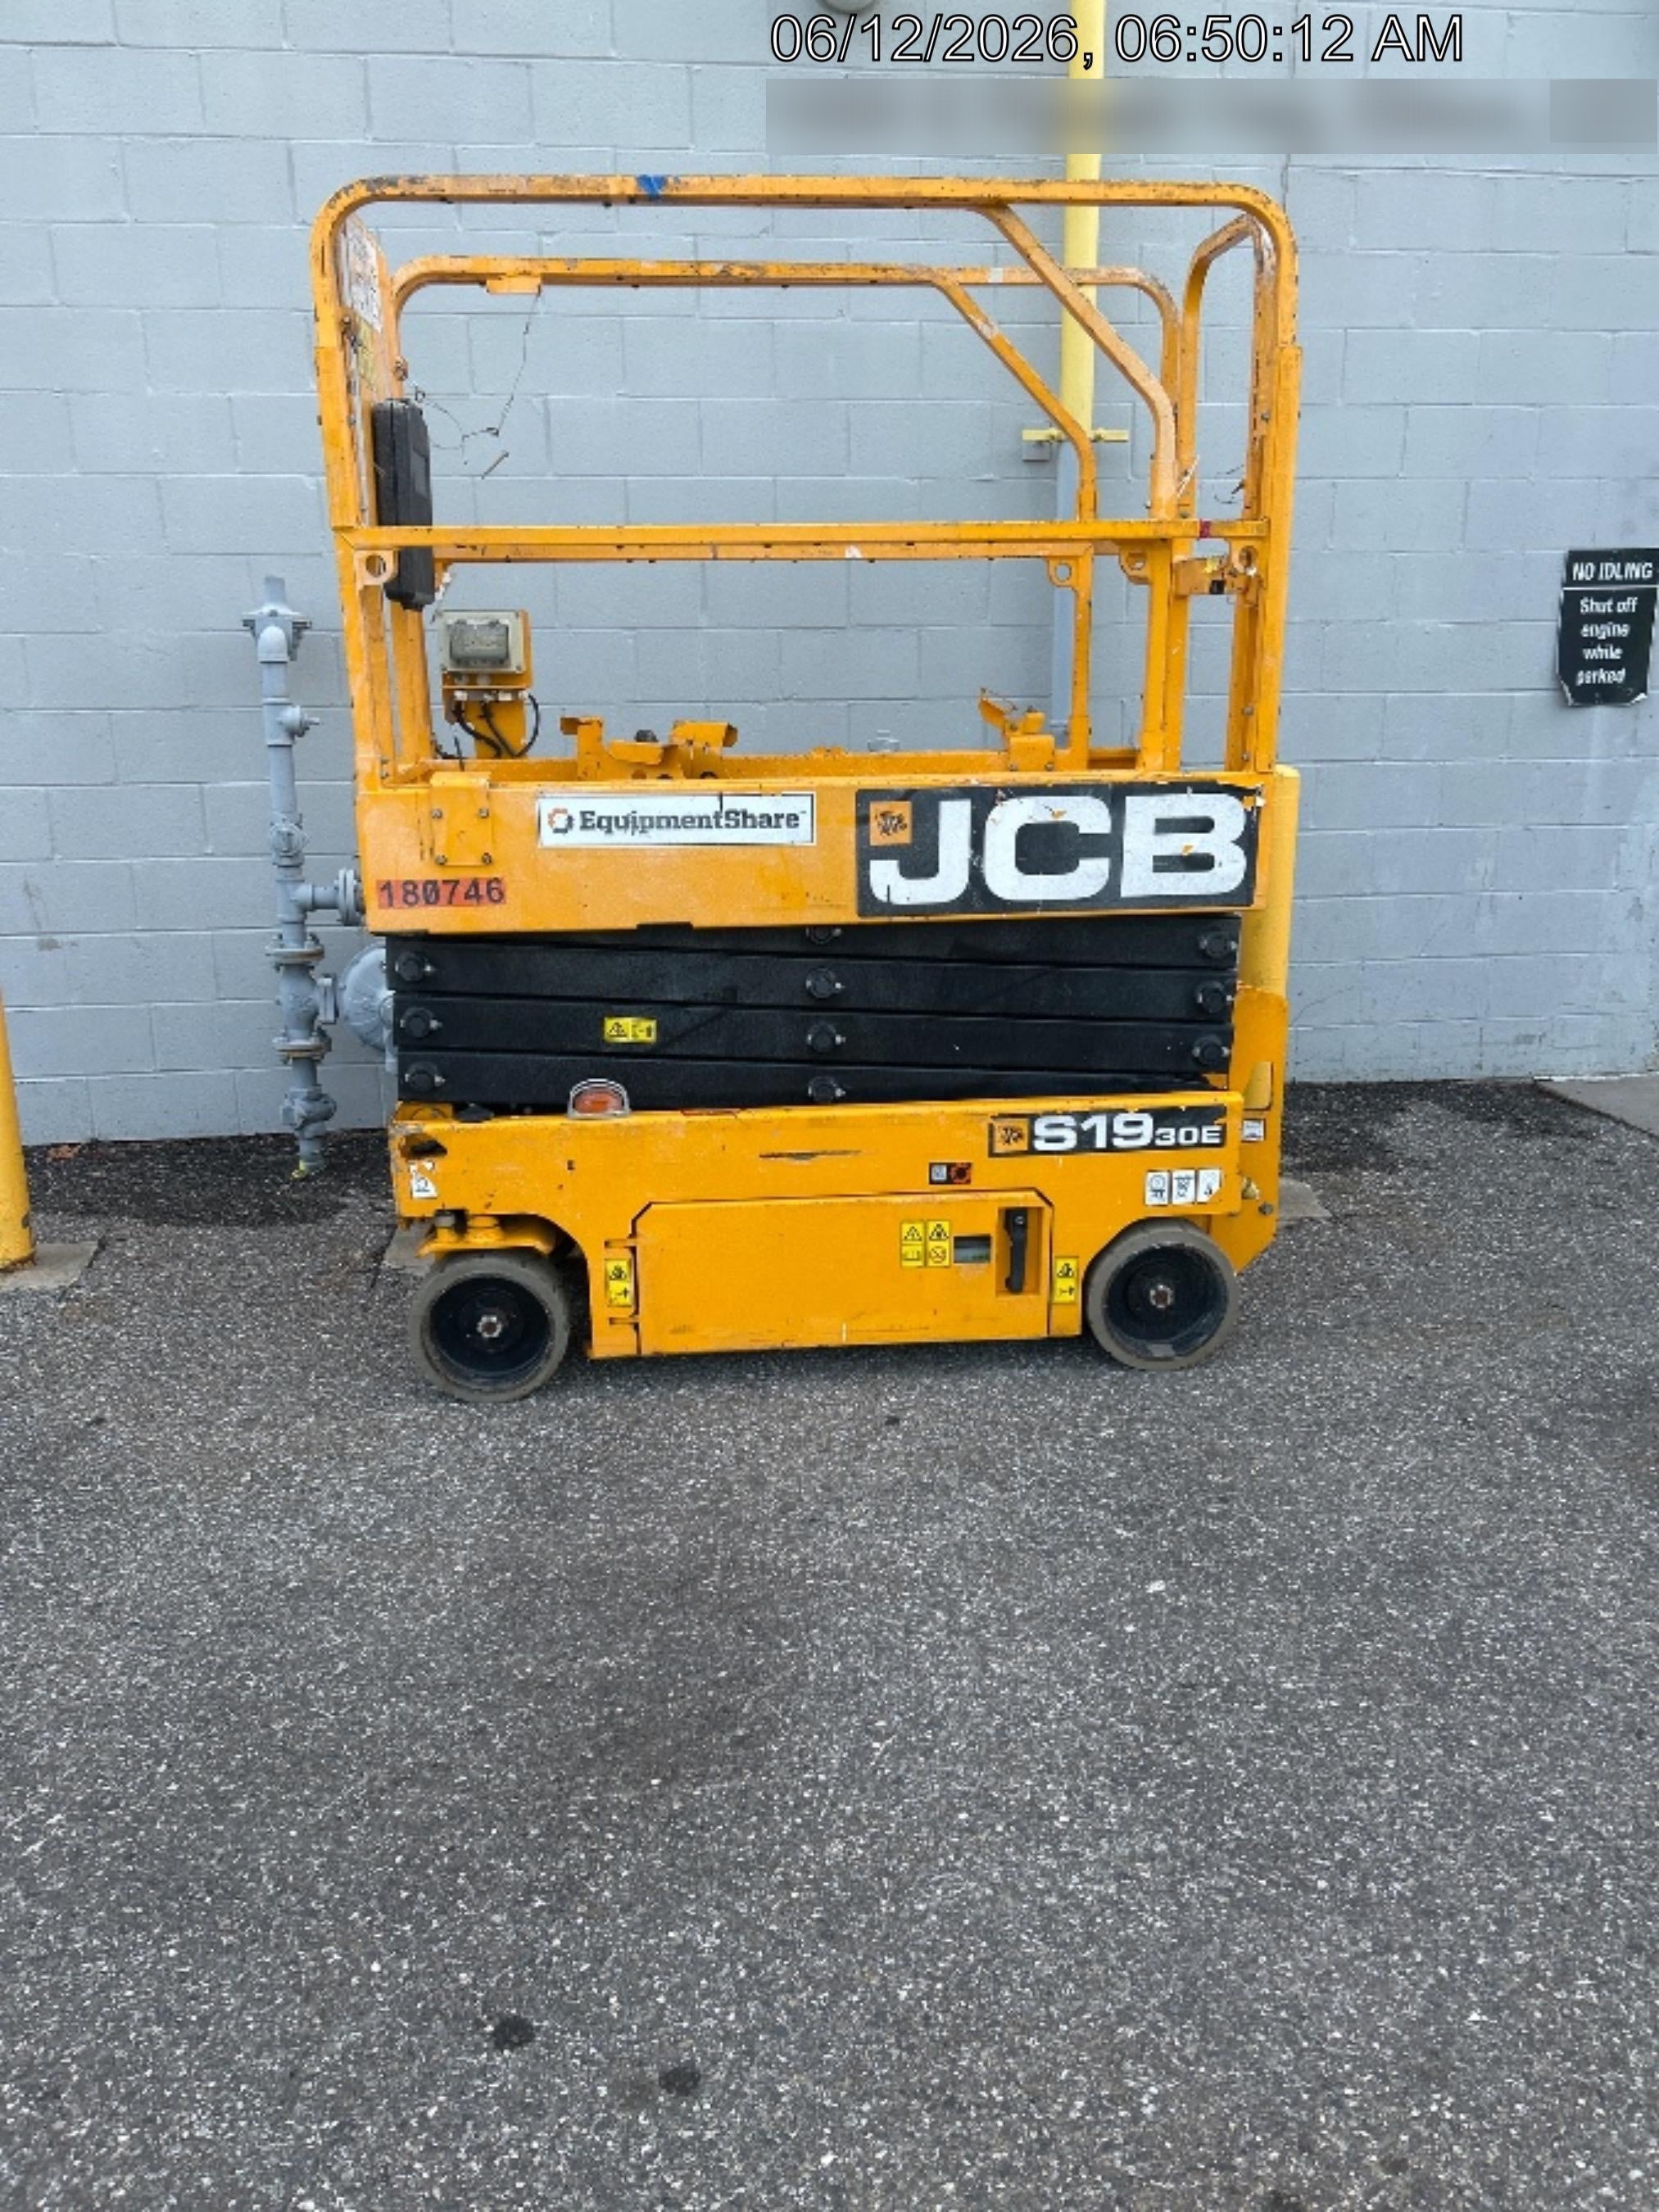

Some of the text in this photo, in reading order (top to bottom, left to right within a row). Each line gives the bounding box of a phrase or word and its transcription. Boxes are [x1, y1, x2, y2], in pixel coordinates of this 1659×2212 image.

[1572, 561, 1653, 581] NO IDLING
[1580, 596, 1638, 614] Shut off
[1580, 622, 1630, 640] engine
[1583, 643, 1623, 660] while
[1575, 668, 1626, 686] parked
[579, 808, 800, 836] EquipmentShare
[869, 793, 1247, 905] JCB
[379, 877, 505, 908] 180746
